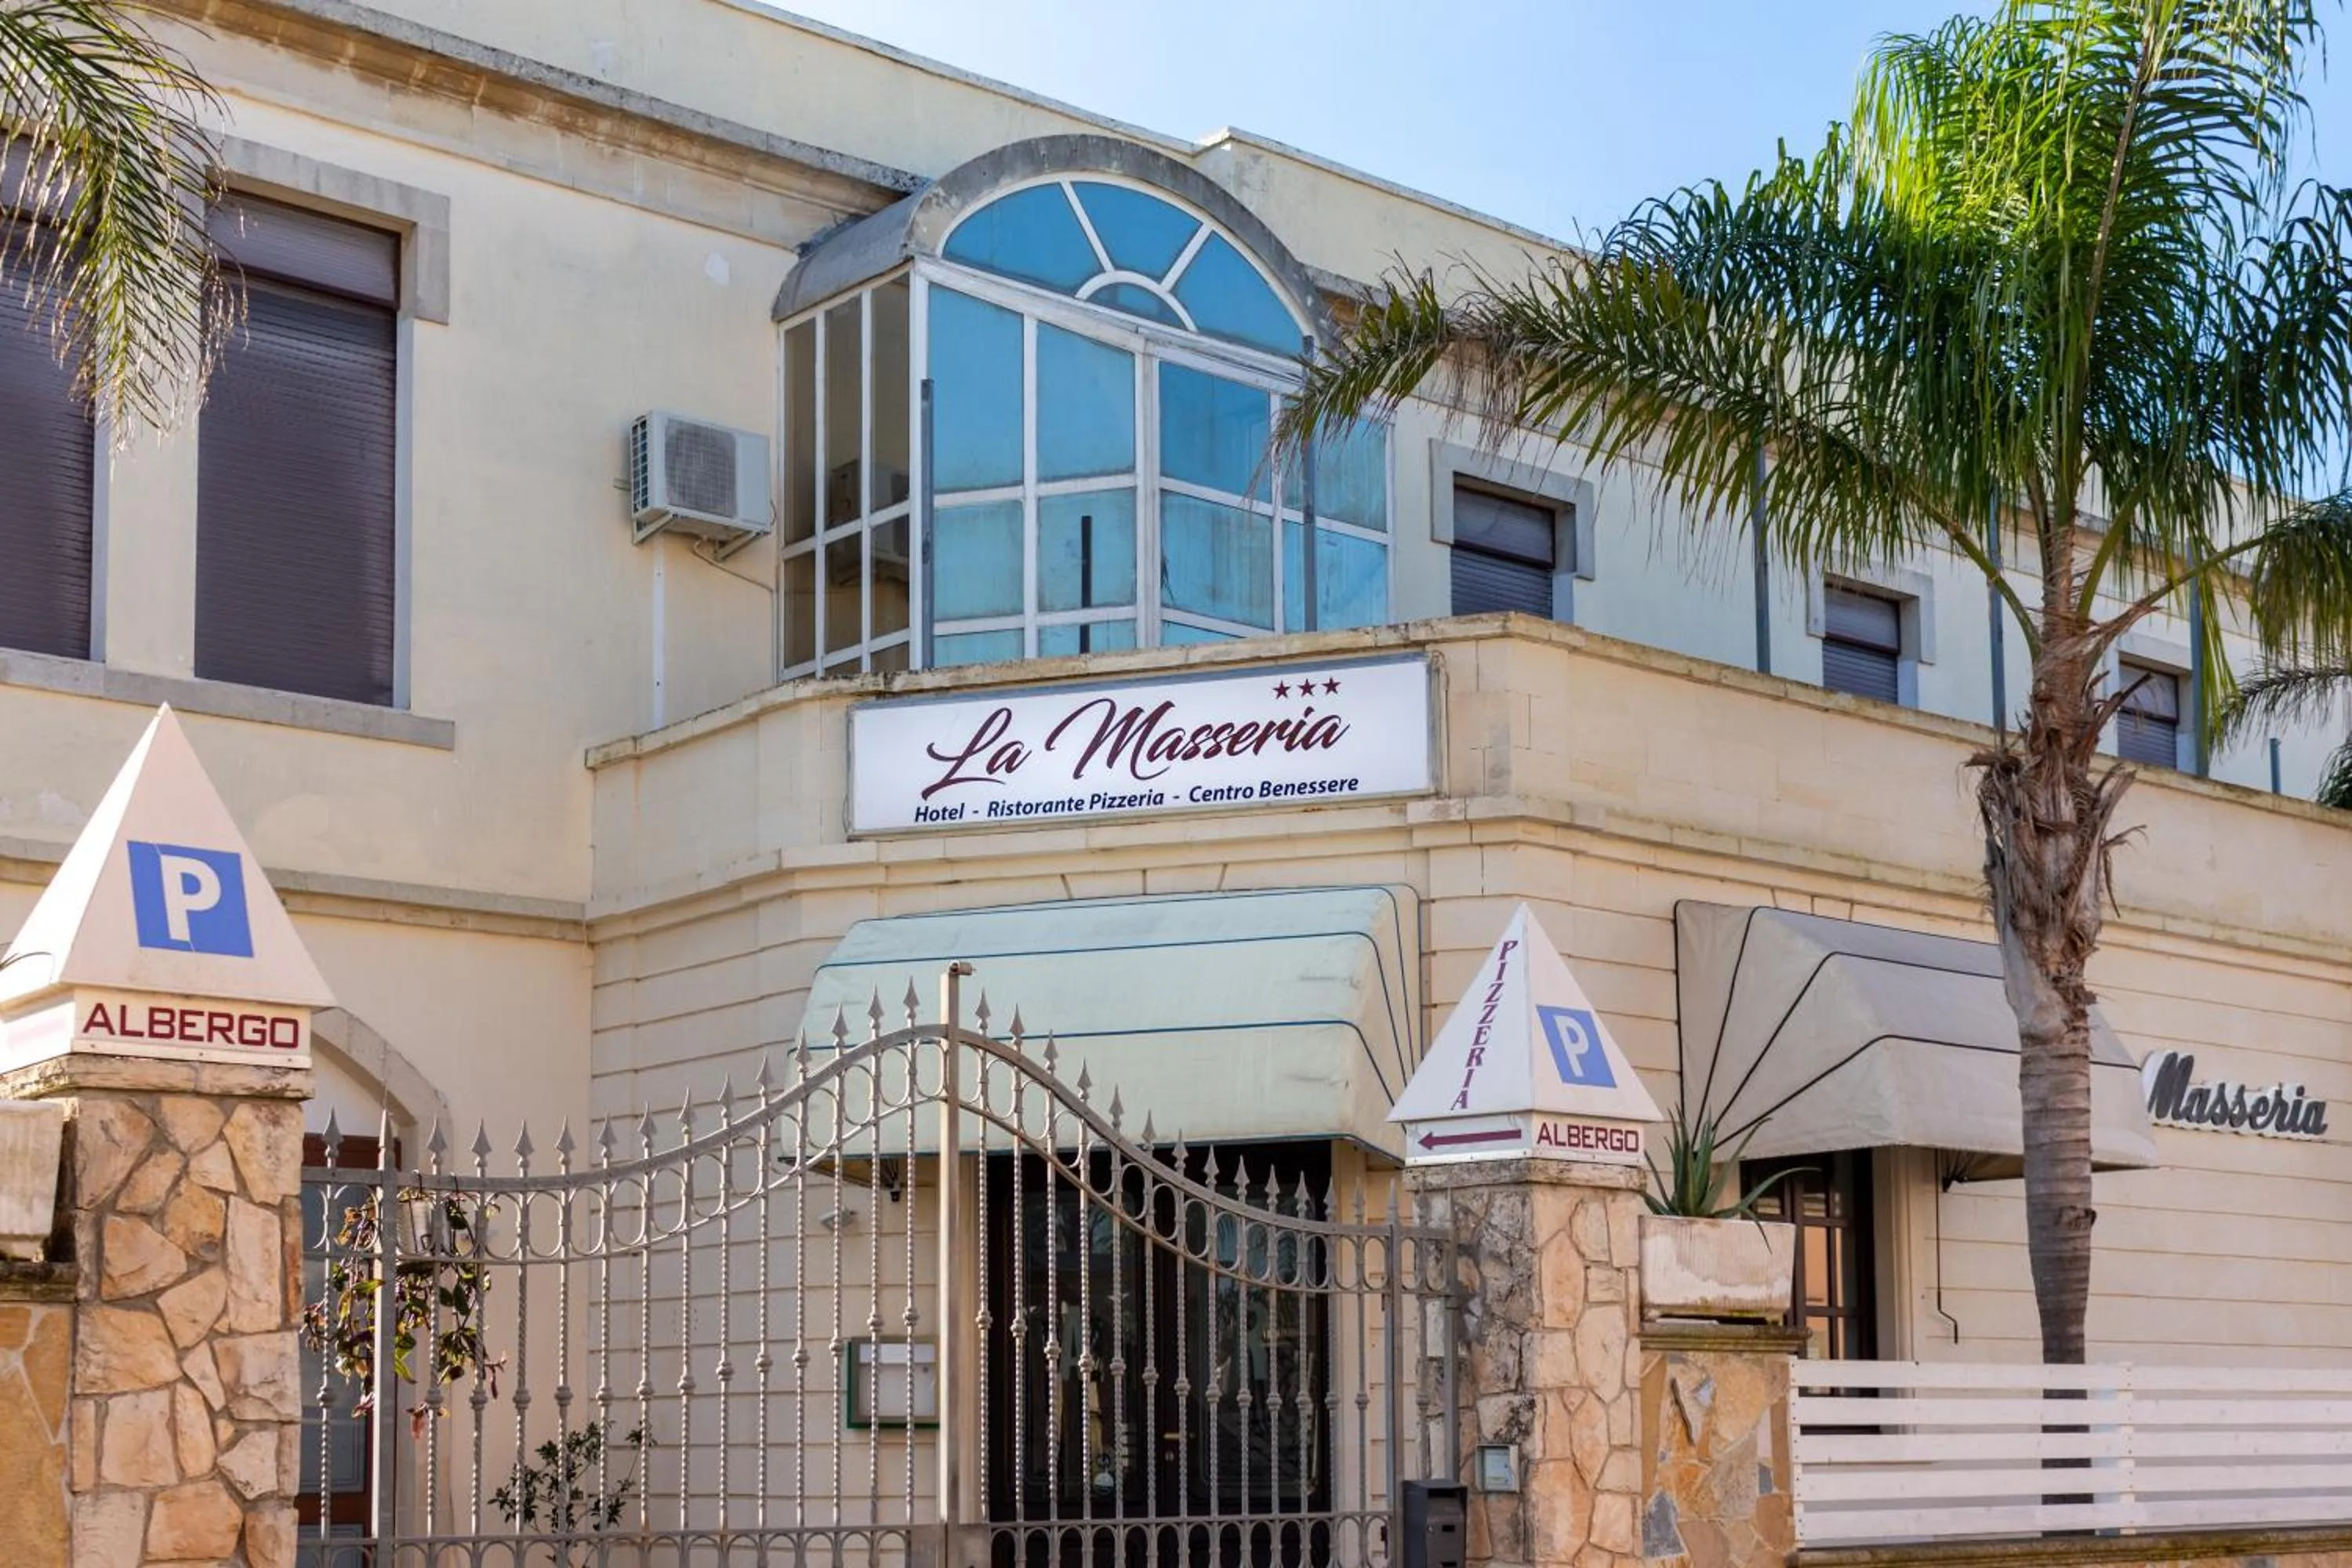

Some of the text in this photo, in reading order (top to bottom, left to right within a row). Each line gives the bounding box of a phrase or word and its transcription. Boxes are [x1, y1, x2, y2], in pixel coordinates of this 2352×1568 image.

[920, 698, 1351, 802] La Masseria
[914, 802, 965, 823] Hotel
[986, 797, 1085, 818] Ristorante
[1089, 789, 1165, 811] Pizzeria
[1189, 785, 1254, 804] Centro
[1258, 778, 1359, 799] Benessere
[160, 854, 222, 942] P
[82, 1003, 299, 1049] ALBERGO
[1450, 940, 1519, 1111] PIZZERIA
[1552, 1014, 1589, 1078] P
[2147, 1051, 2328, 1136] Masseria
[1536, 1122, 1639, 1153] ALBERGO
